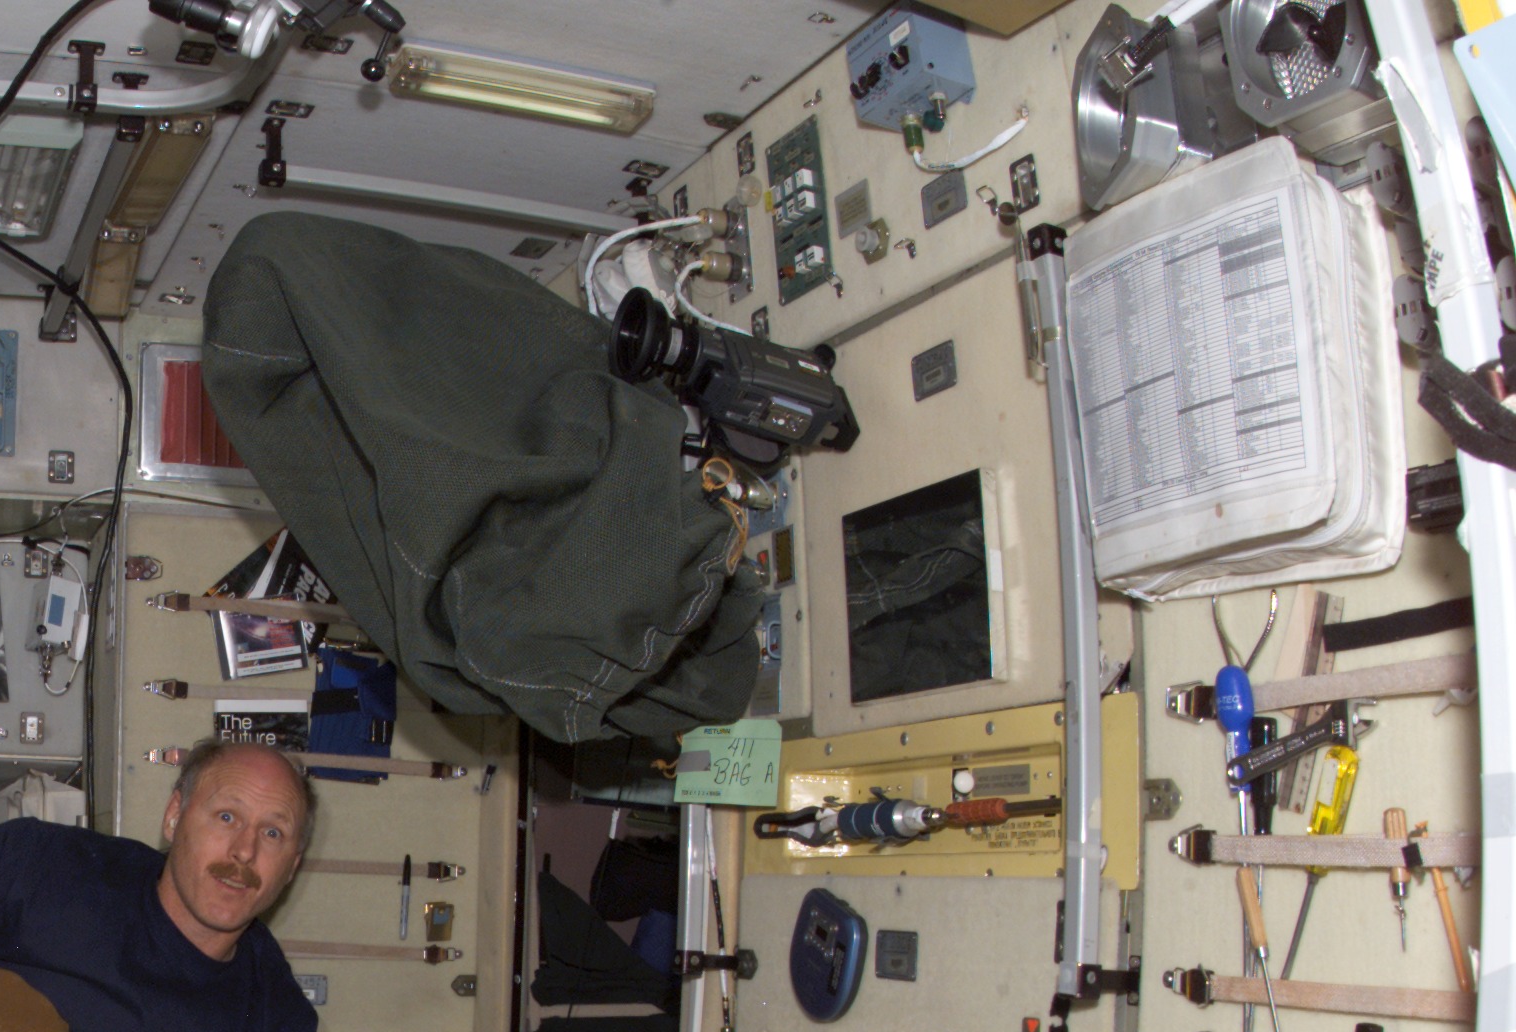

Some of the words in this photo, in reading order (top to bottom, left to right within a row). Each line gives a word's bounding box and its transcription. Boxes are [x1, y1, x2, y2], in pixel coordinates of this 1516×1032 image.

[220, 714, 252, 730] The
[220, 730, 276, 745] Future
[728, 738, 755, 758] 411
[713, 757, 752, 787] BAG
[764, 761, 774, 784] A
